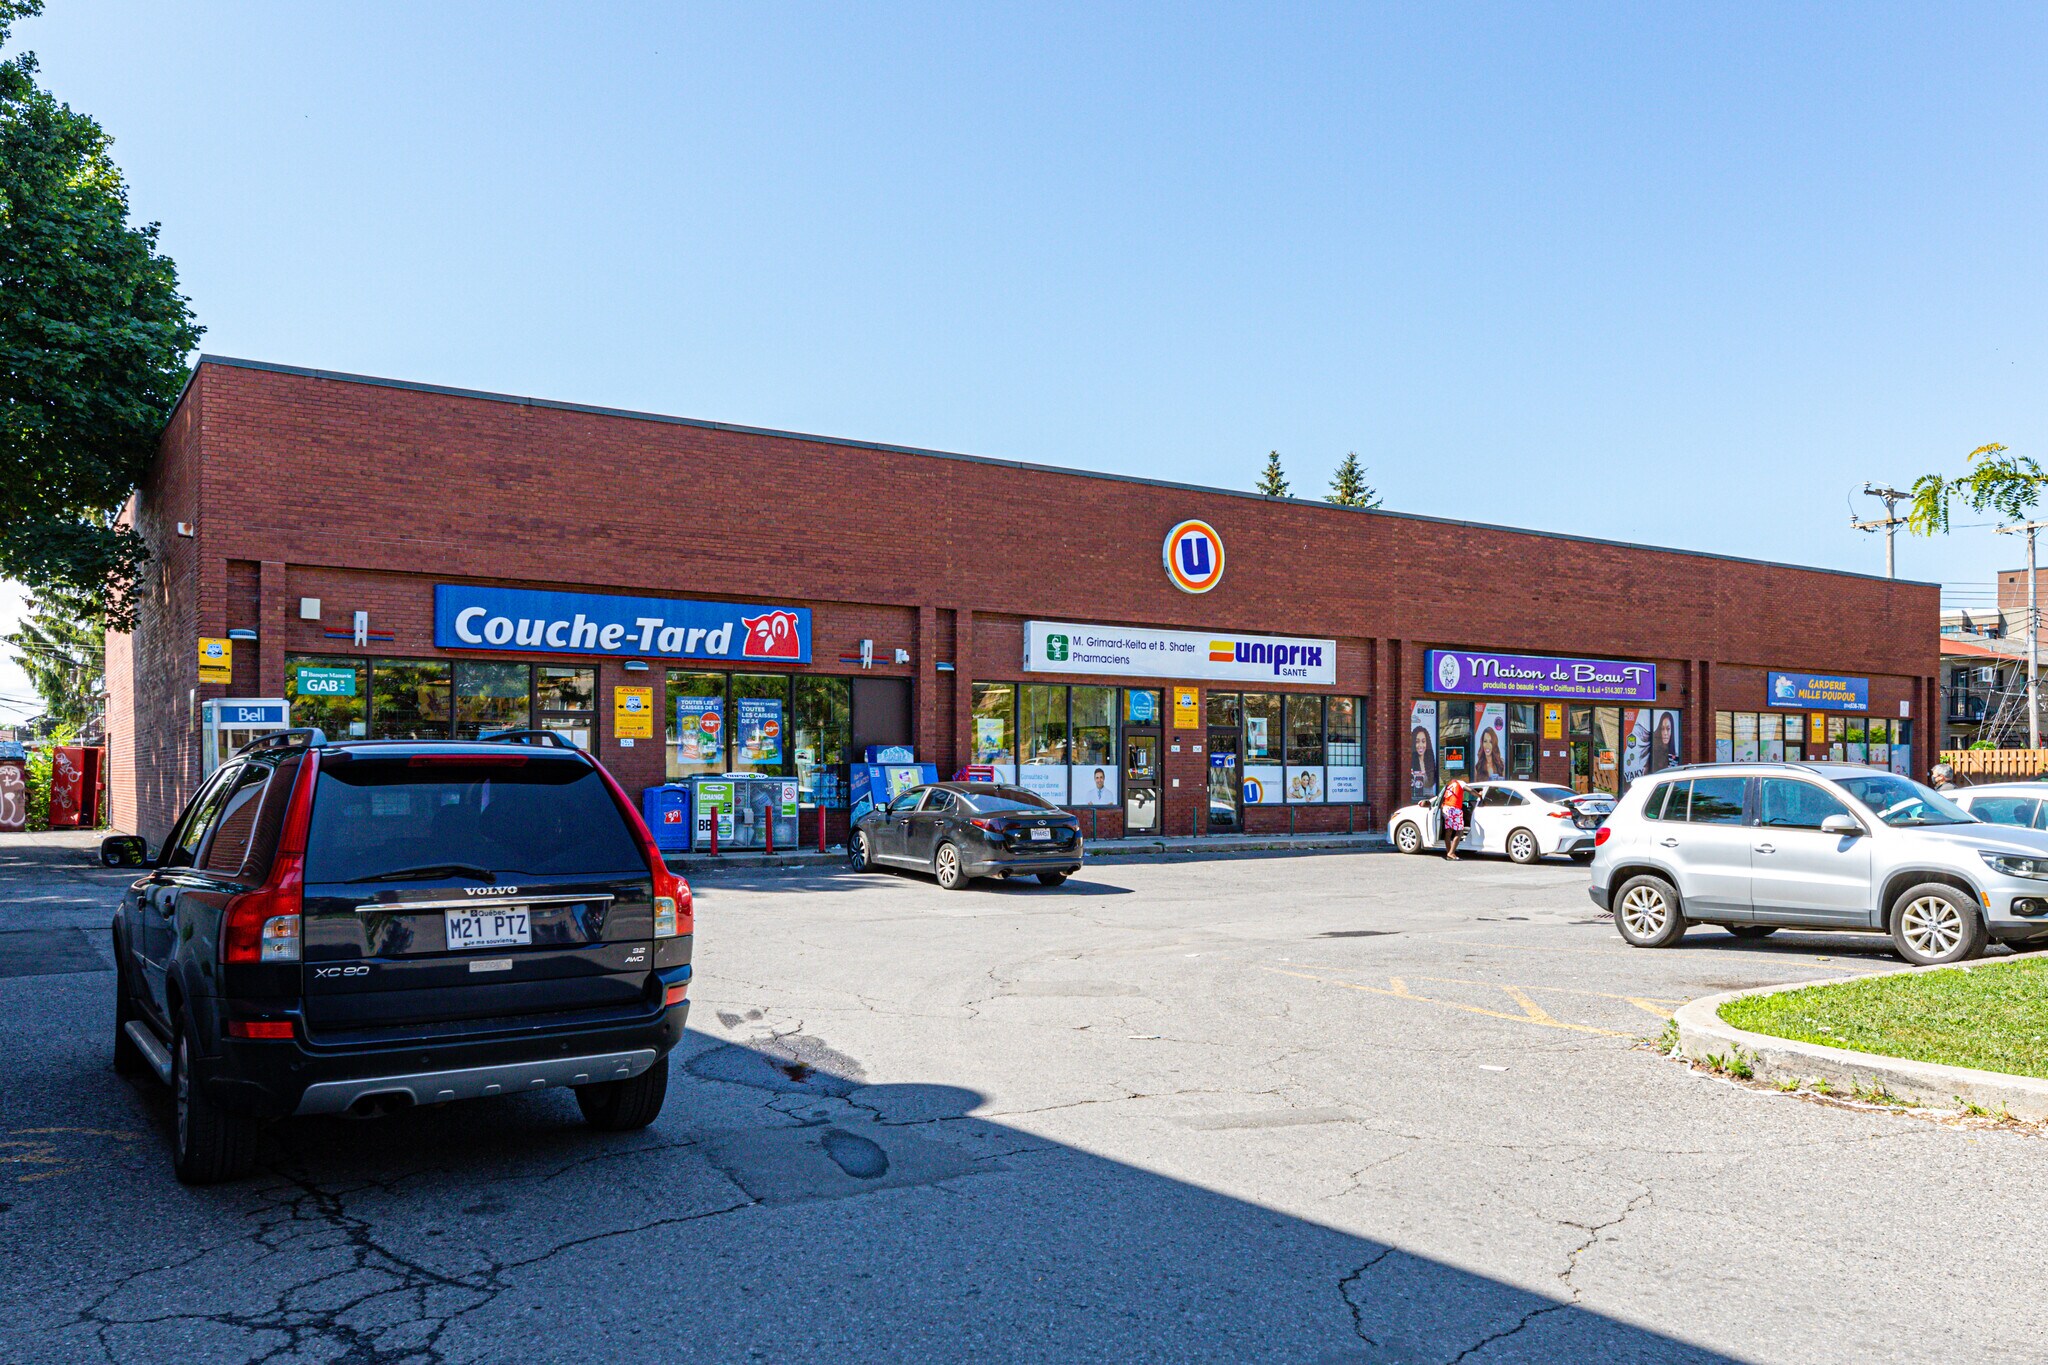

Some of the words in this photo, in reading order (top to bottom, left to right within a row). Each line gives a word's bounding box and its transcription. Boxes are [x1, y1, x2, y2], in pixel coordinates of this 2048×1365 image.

[454, 606, 733, 656] Couche-Tard
[1072, 636, 1083, 647] M.
[1086, 636, 1147, 650] Grimard-Keita
[1149, 640, 1157, 651] et
[1159, 641, 1167, 651] B.
[1169, 641, 1196, 653] Shater
[1072, 652, 1130, 665] Pharmaciens
[1282, 667, 1307, 677] SANTÉ
[1466, 656, 1546, 680] Maison
[1549, 663, 1570, 681] de
[306, 679, 339, 692] GAB
[1482, 682, 1507, 690] produits
[1507, 682, 1515, 690] de
[1538, 683, 1550, 692] Spa
[1808, 679, 1847, 691] GARDERIE
[1798, 689, 1820, 699] MILLE
[1822, 691, 1855, 702] DOUDOUS
[238, 707, 265, 722] Bell
[1624, 768, 1645, 782] YAKY
[700, 793, 725, 801] ÉCHANGE
[463, 886, 518, 896] VOLVO
[478, 909, 507, 917] Québec
[450, 917, 482, 939] M21
[494, 914, 527, 936] PTZ
[624, 955, 645, 963] AWD
[314, 965, 370, 979] XC90
